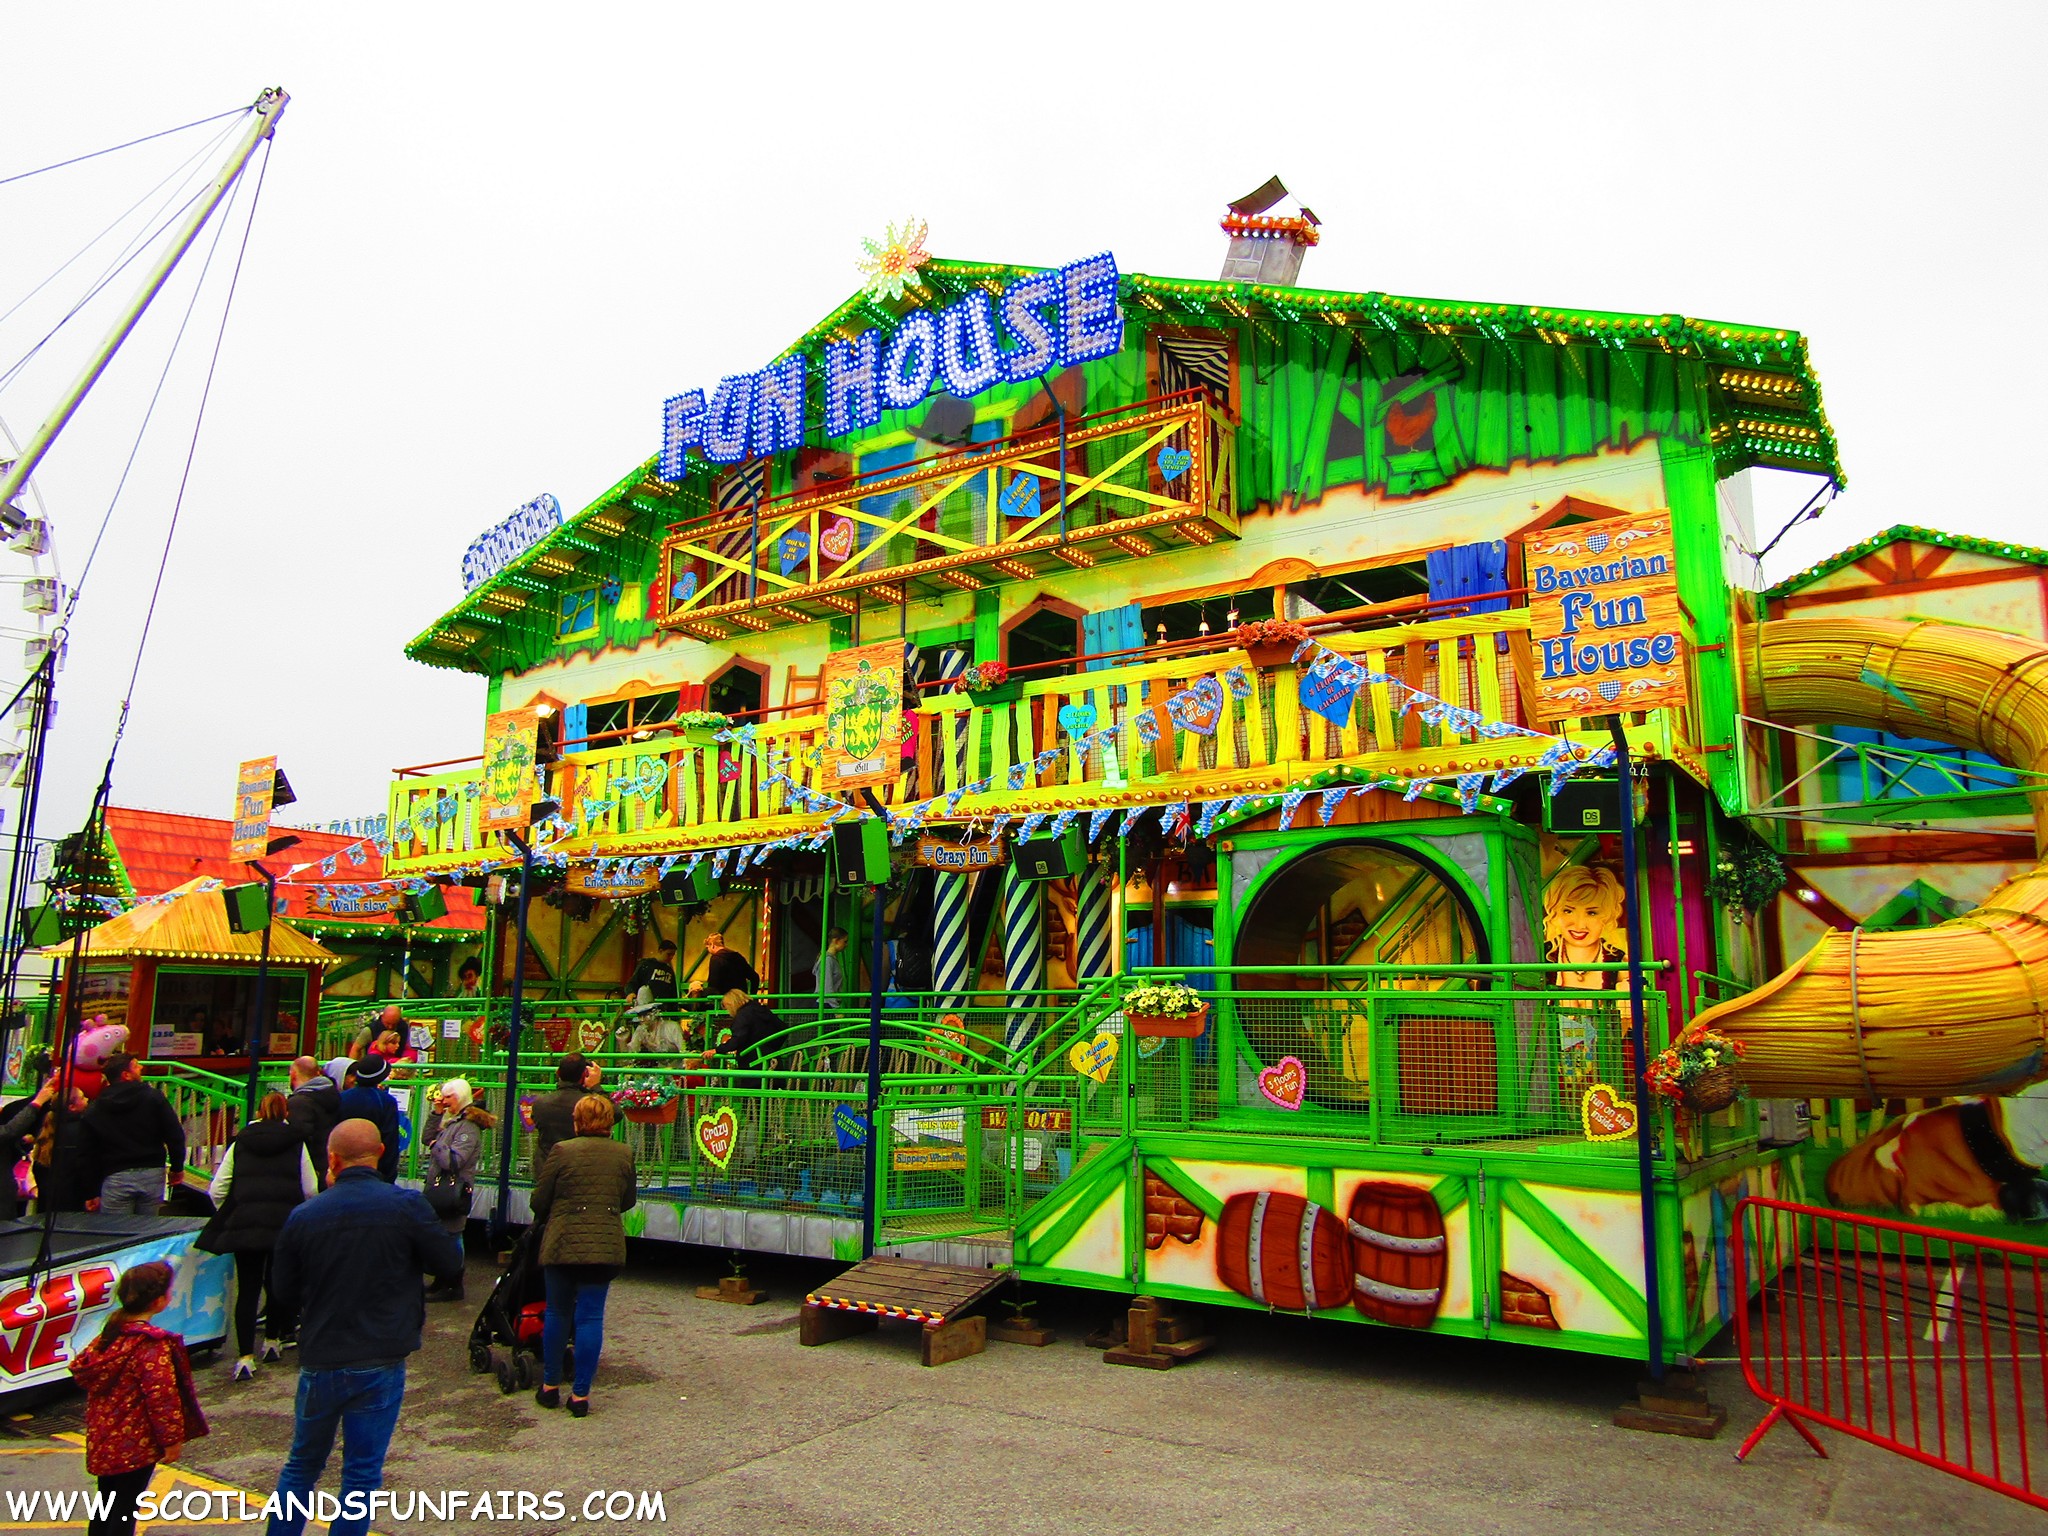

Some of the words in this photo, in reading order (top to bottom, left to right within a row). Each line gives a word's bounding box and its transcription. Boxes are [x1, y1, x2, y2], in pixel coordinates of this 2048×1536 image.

[658, 355, 806, 483] FUN
[824, 250, 1125, 438] HOUSE
[1534, 554, 1668, 593] Bavarian
[1559, 592, 1647, 634] Fun
[1538, 634, 1675, 679] House
[854, 761, 869, 773] Gill
[239, 780, 272, 795] Bavarian
[242, 796, 264, 819] Fun
[1585, 812, 1598, 820] DS
[234, 820, 268, 842] House
[935, 845, 967, 868] Crazy
[969, 846, 989, 865] Fun
[329, 899, 360, 913] Walk
[363, 900, 388, 911] slow
[1267, 1080, 1274, 1089] 3
[1273, 1069, 1296, 1086] floors
[1276, 1085, 1284, 1097] of
[1285, 1080, 1299, 1092] fun
[916, 1120, 938, 1130] THIS
[940, 1120, 959, 1130] WAY
[1591, 1110, 1615, 1131] inside
[1604, 1105, 1615, 1118] on
[1615, 1113, 1631, 1130] the
[703, 1122, 728, 1141] Crazy
[837, 1119, 862, 1140] WELCOME
[710, 1138, 727, 1154] Fun
[896, 1153, 928, 1164] Slippery
